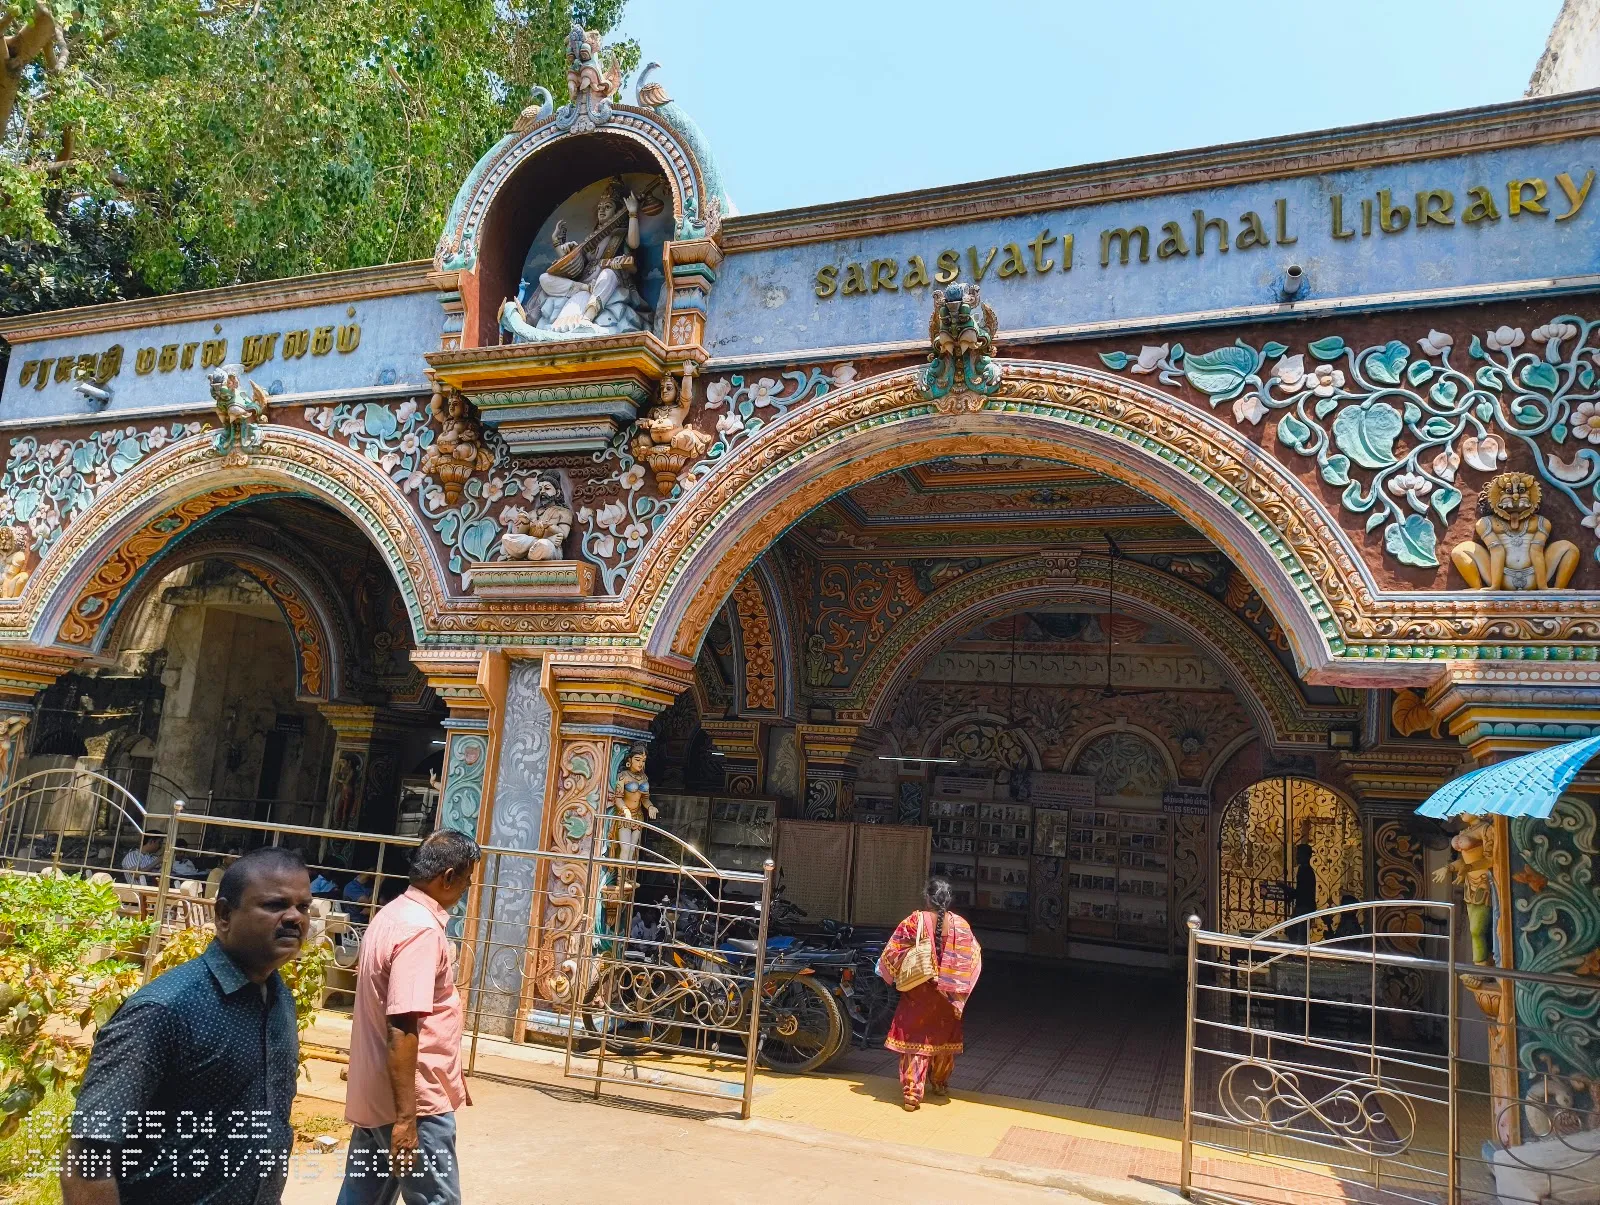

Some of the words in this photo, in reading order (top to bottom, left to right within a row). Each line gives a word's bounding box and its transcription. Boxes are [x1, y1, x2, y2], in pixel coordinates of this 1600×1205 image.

[135, 323, 228, 375] மகால்
[241, 305, 362, 372] நூலகம்
[1163, 805, 1182, 813] SALES
[1182, 806, 1208, 815] SECTION
